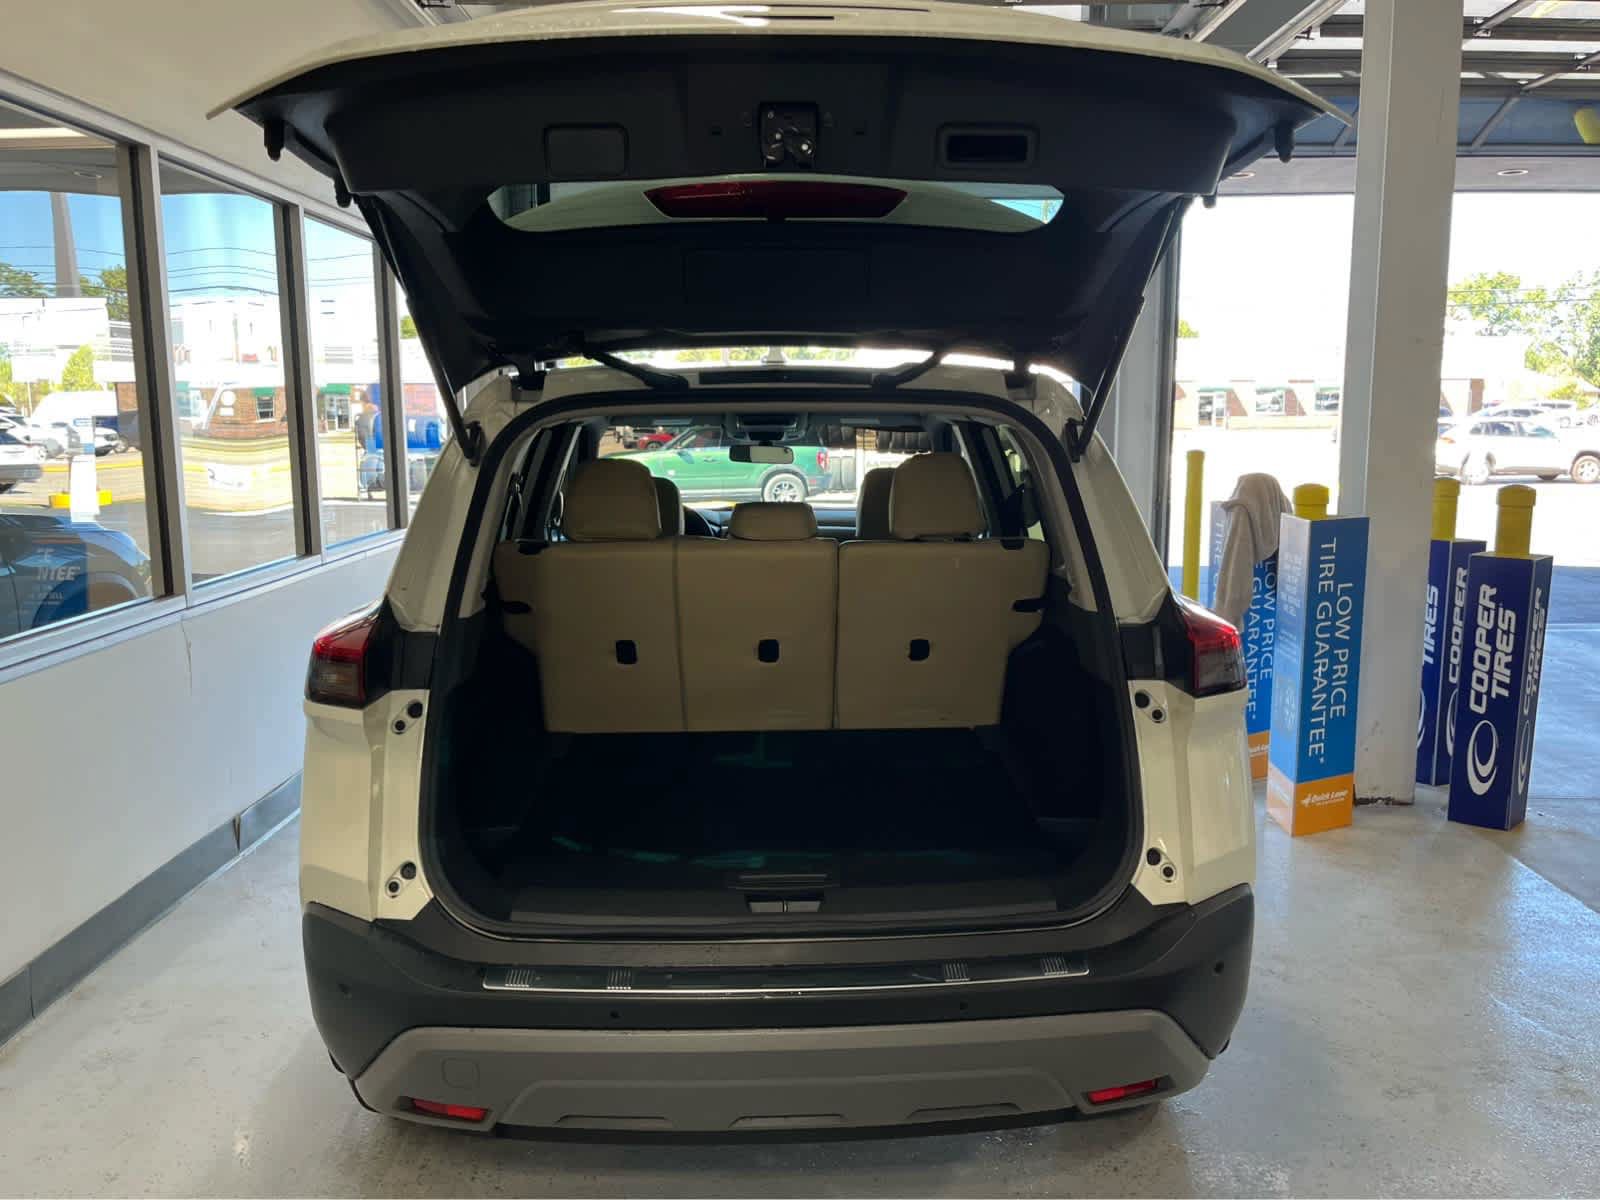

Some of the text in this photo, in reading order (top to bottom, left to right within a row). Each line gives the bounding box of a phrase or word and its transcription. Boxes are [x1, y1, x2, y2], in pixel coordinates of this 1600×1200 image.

[1260, 561, 1277, 681] LOW PRICE
[1318, 537, 1337, 594] TIRE
[1330, 583, 1353, 719] LOW PRICE
[1422, 584, 1439, 665] TIRES
[1449, 567, 1468, 684] COOPER
[1469, 584, 1497, 715] COOPER
[1491, 607, 1516, 699] TIRES
